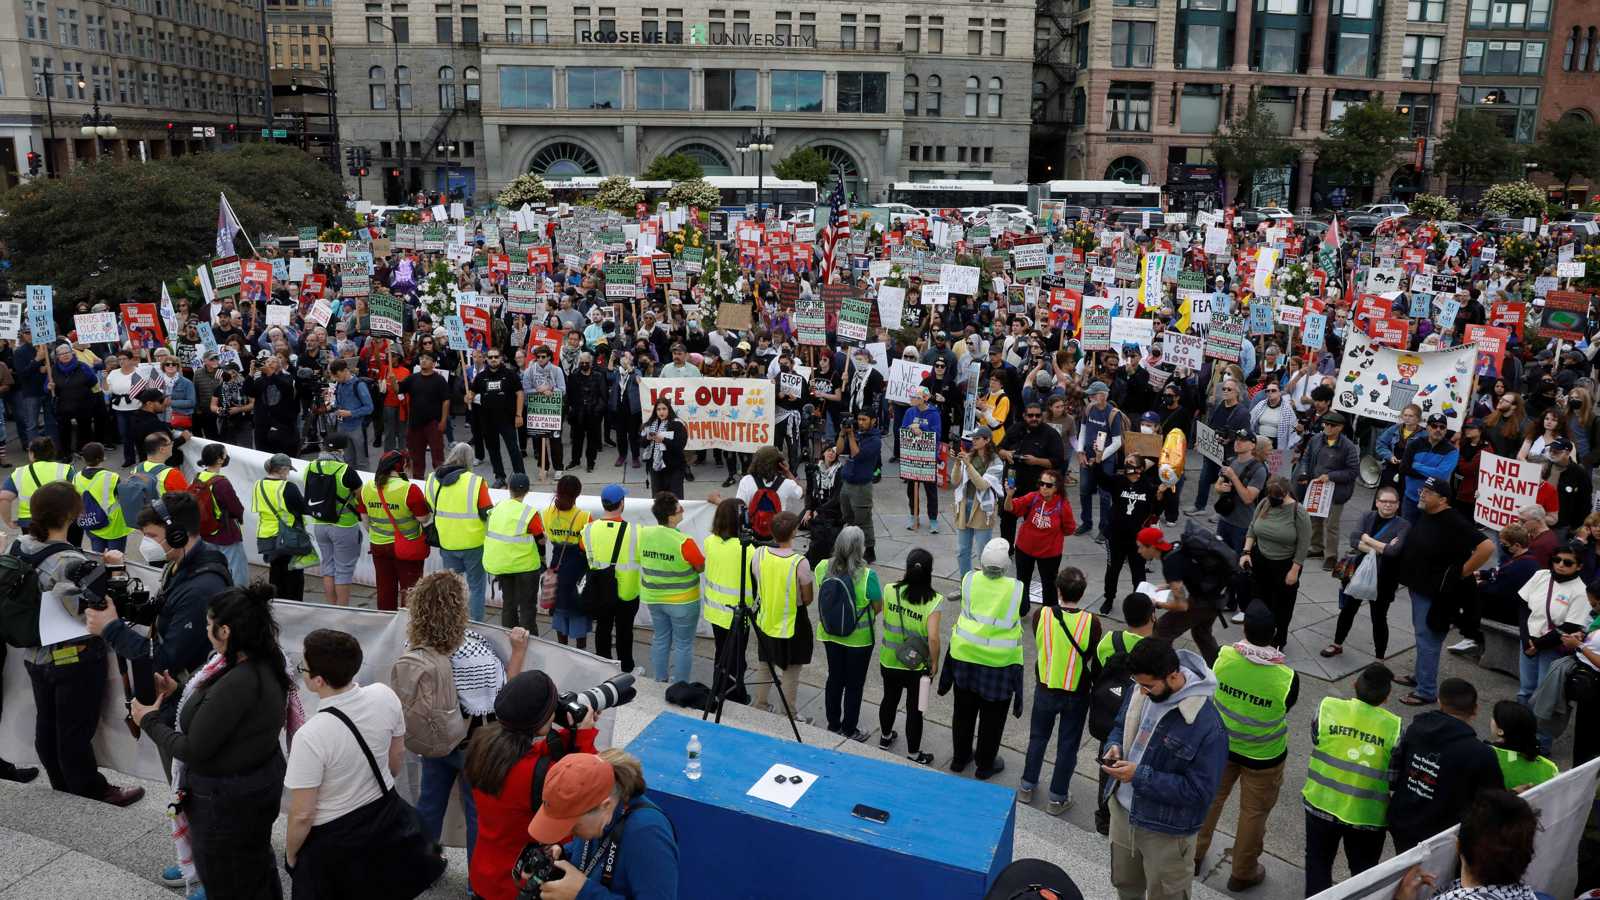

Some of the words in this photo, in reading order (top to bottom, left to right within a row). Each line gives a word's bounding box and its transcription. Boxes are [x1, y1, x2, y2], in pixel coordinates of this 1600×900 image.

[581, 30, 683, 44] ROOSEVELT
[712, 33, 815, 47] UNIVERSITY
[322, 243, 343, 254] STOP
[370, 298, 402, 312] CHICAGO
[842, 303, 869, 315] CHICAGO
[371, 318, 401, 330] OCCUPATION
[841, 314, 867, 326] PALESTINE
[1212, 313, 1229, 322] STOP
[1231, 316, 1244, 325] THE
[840, 323, 866, 332] OCCUPATION
[1165, 332, 1201, 349] TROOPS
[1174, 345, 1189, 354] GO
[1164, 352, 1195, 368] HOME
[902, 363, 919, 384] WE
[782, 374, 801, 386] STOP
[528, 396, 561, 404] CHICAGO
[650, 387, 685, 406] ICE
[695, 386, 744, 406] OUT
[528, 407, 560, 415] PALESTINE
[687, 421, 769, 443] MMUNITIES
[921, 431, 935, 440] THE
[1496, 459, 1520, 477] NO
[1480, 469, 1540, 501] TYRANT
[1476, 503, 1521, 527] TROOP
[78, 516, 99, 527] GIRL
[643, 550, 658, 558] SAFETY
[659, 553, 675, 562] TEAM
[906, 610, 923, 622] TEAM
[1218, 681, 1247, 702] SAFETY
[1248, 694, 1272, 709] TEAM
[1328, 724, 1359, 740] SAFETY
[1360, 731, 1385, 748] TEAM
[605, 841, 617, 873] SONY
